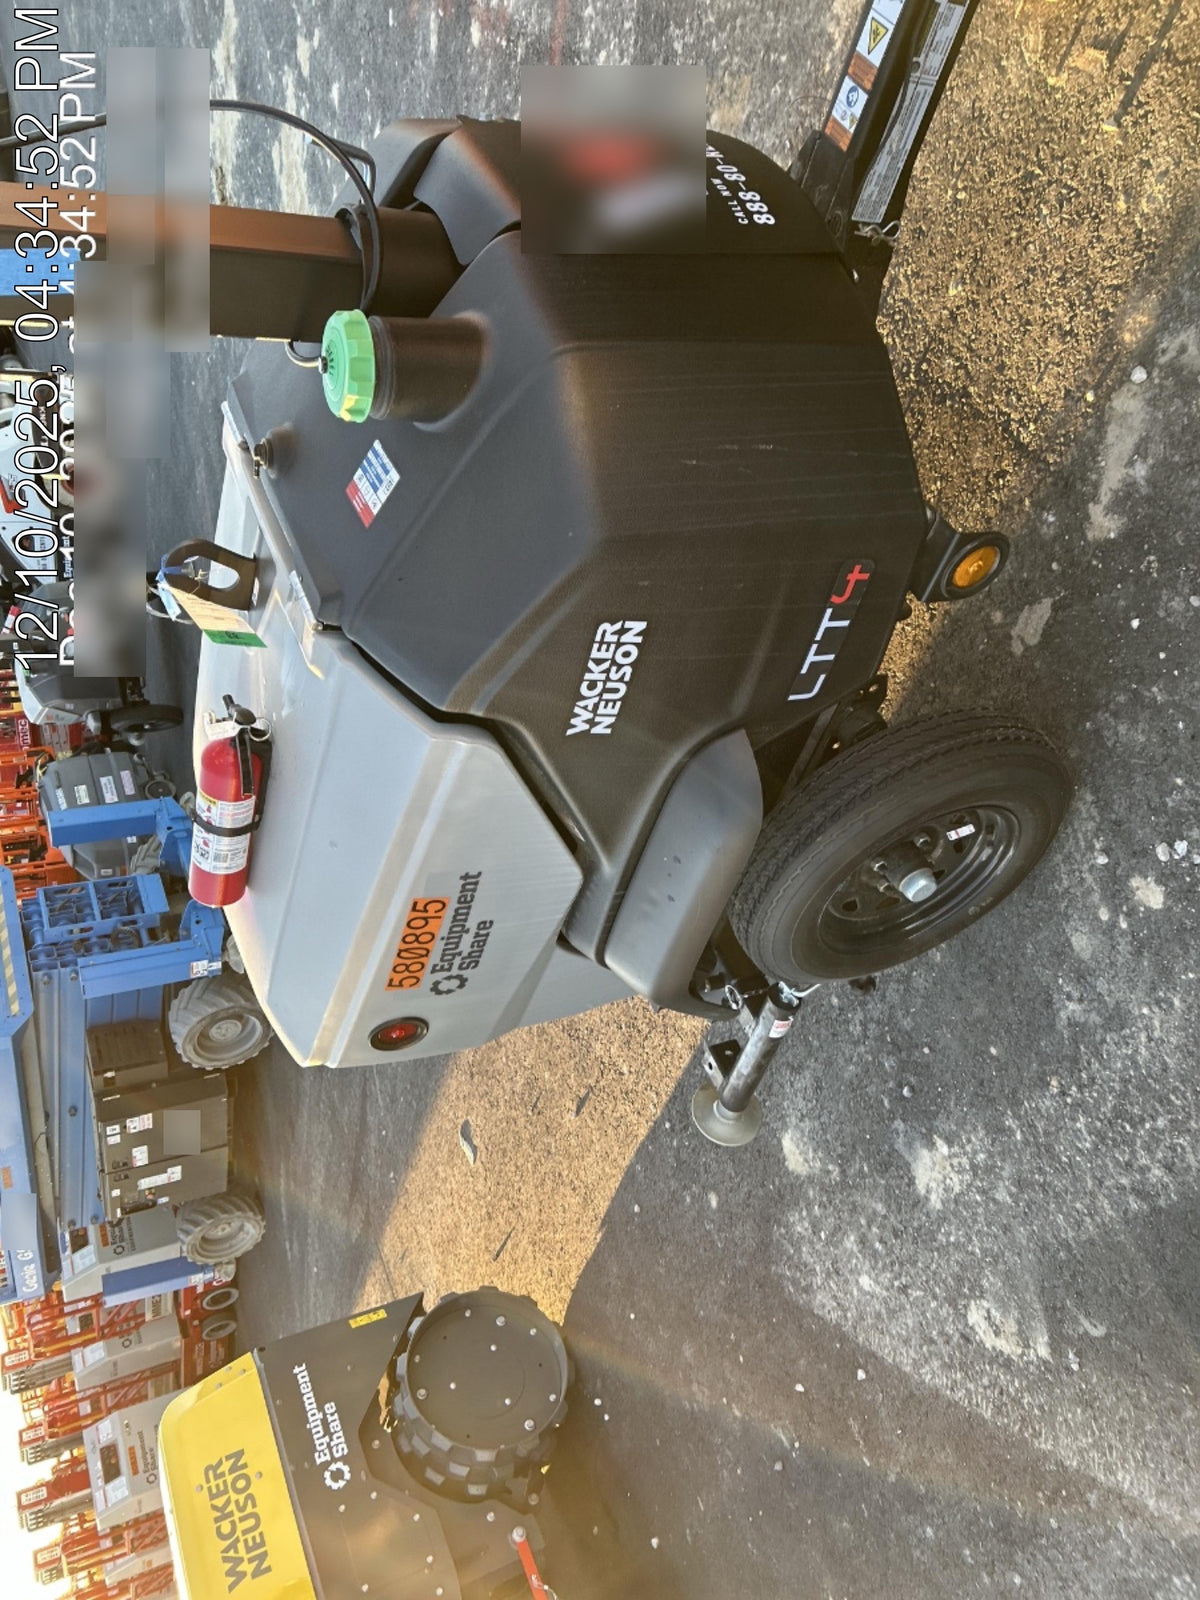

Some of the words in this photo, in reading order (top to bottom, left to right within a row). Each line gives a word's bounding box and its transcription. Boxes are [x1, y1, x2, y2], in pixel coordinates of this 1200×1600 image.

[710, 177, 732, 197] NOW
[728, 199, 749, 225] CALL
[565, 620, 623, 736] WACKER
[590, 620, 648, 736] NEUSON
[787, 564, 871, 702] LTT4
[18, 719, 31, 745] mec
[387, 897, 447, 989] 580895
[431, 871, 482, 974] Equipment
[458, 920, 494, 971] Share
[21, 1263, 38, 1292] Genie
[291, 1363, 333, 1465] Equipment
[321, 1401, 349, 1459] Share
[202, 1456, 247, 1593] WACKER
[224, 1449, 272, 1580] NEUSON
